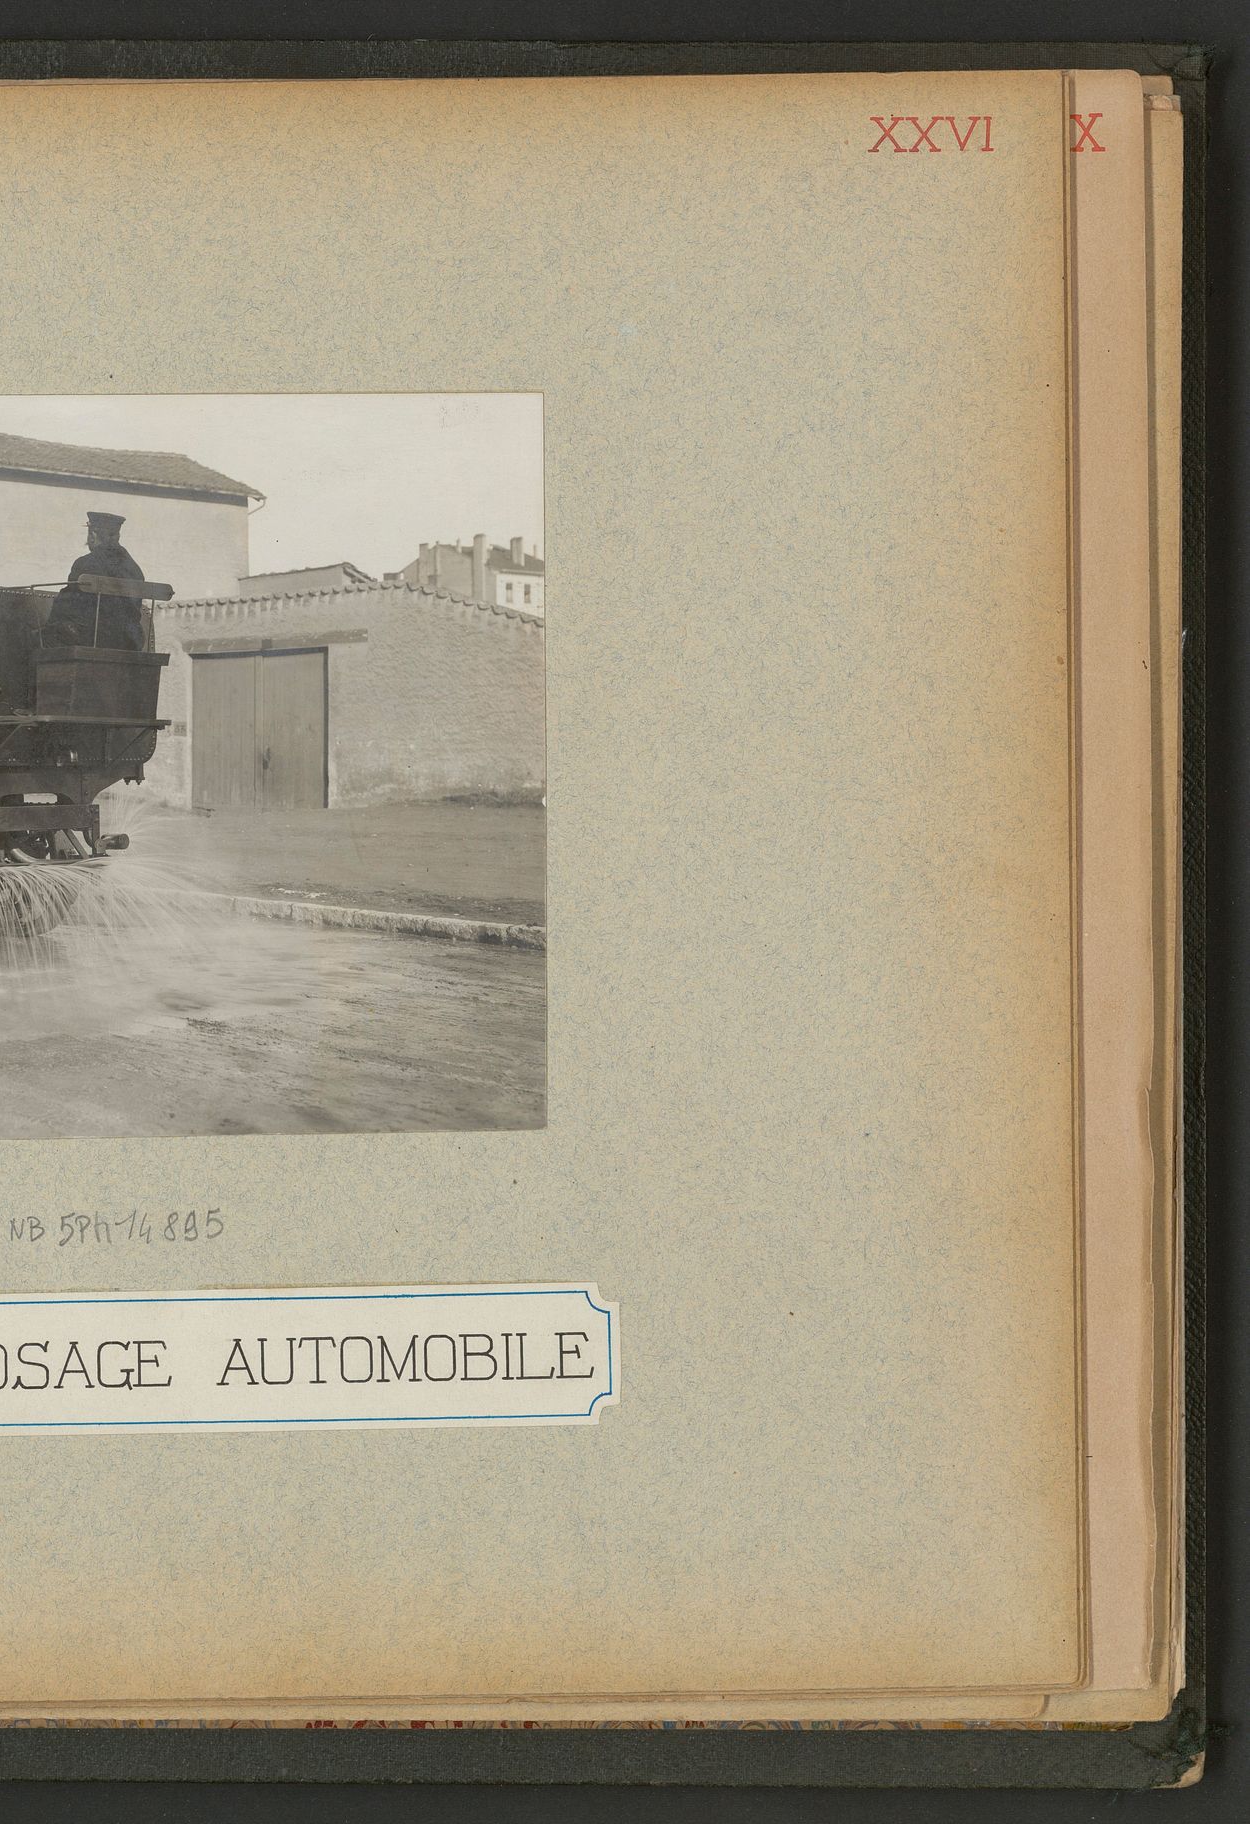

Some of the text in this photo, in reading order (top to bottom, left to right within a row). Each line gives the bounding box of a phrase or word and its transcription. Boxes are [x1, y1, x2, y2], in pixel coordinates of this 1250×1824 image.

[868, 116, 994, 152] XXVI
[1070, 113, 1105, 152] X
[10, 1216, 45, 1242] NB
[216, 1331, 595, 1386] AUTOMOBILE
